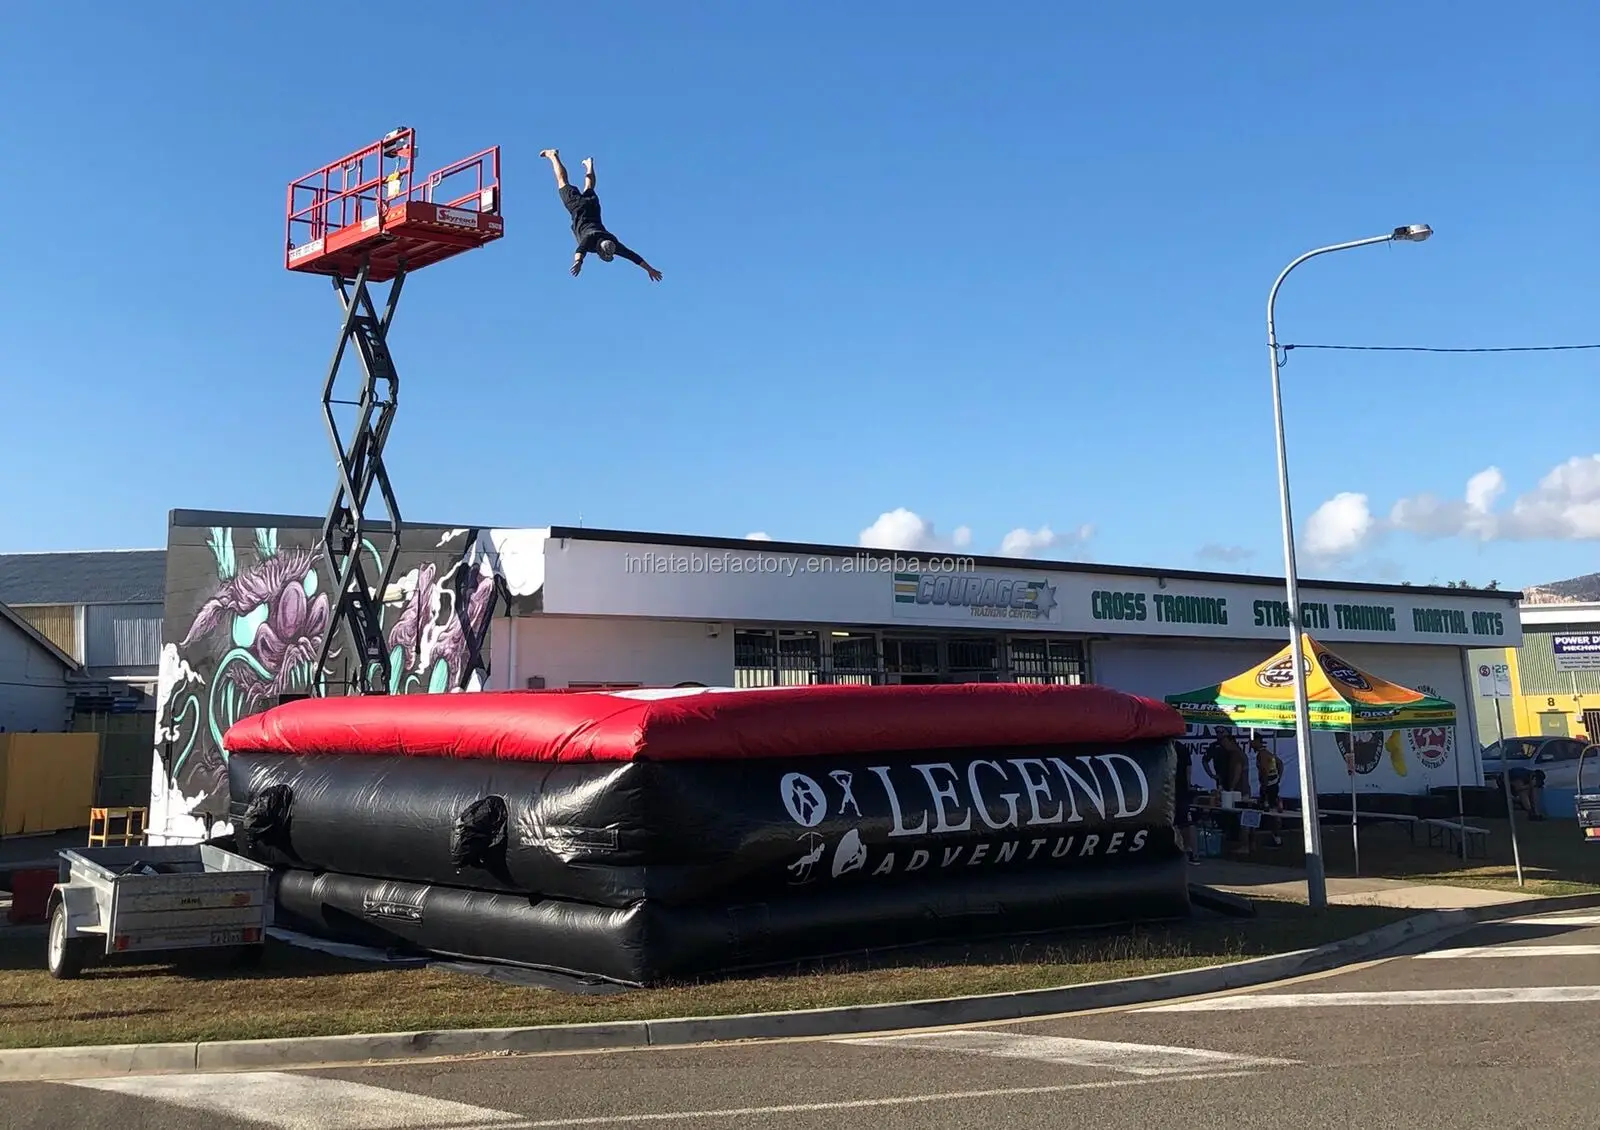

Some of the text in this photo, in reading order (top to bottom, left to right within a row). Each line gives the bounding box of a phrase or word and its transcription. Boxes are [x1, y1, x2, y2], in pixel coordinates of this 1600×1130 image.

[916, 575, 1029, 608] COURAGE
[970, 607, 1037, 620] TRAINING CENTRE
[1091, 590, 1228, 625] CROSS TRAINING
[1254, 599, 1396, 631] STREGTH TRAINING
[1413, 607, 1504, 636] MARTIAL ARTS
[1555, 636, 1590, 645] POWER
[1495, 664, 1509, 673] 2P
[1547, 697, 1555, 707] 8
[868, 753, 1149, 837] LEGEND
[872, 830, 1149, 876] ADVENTURES
